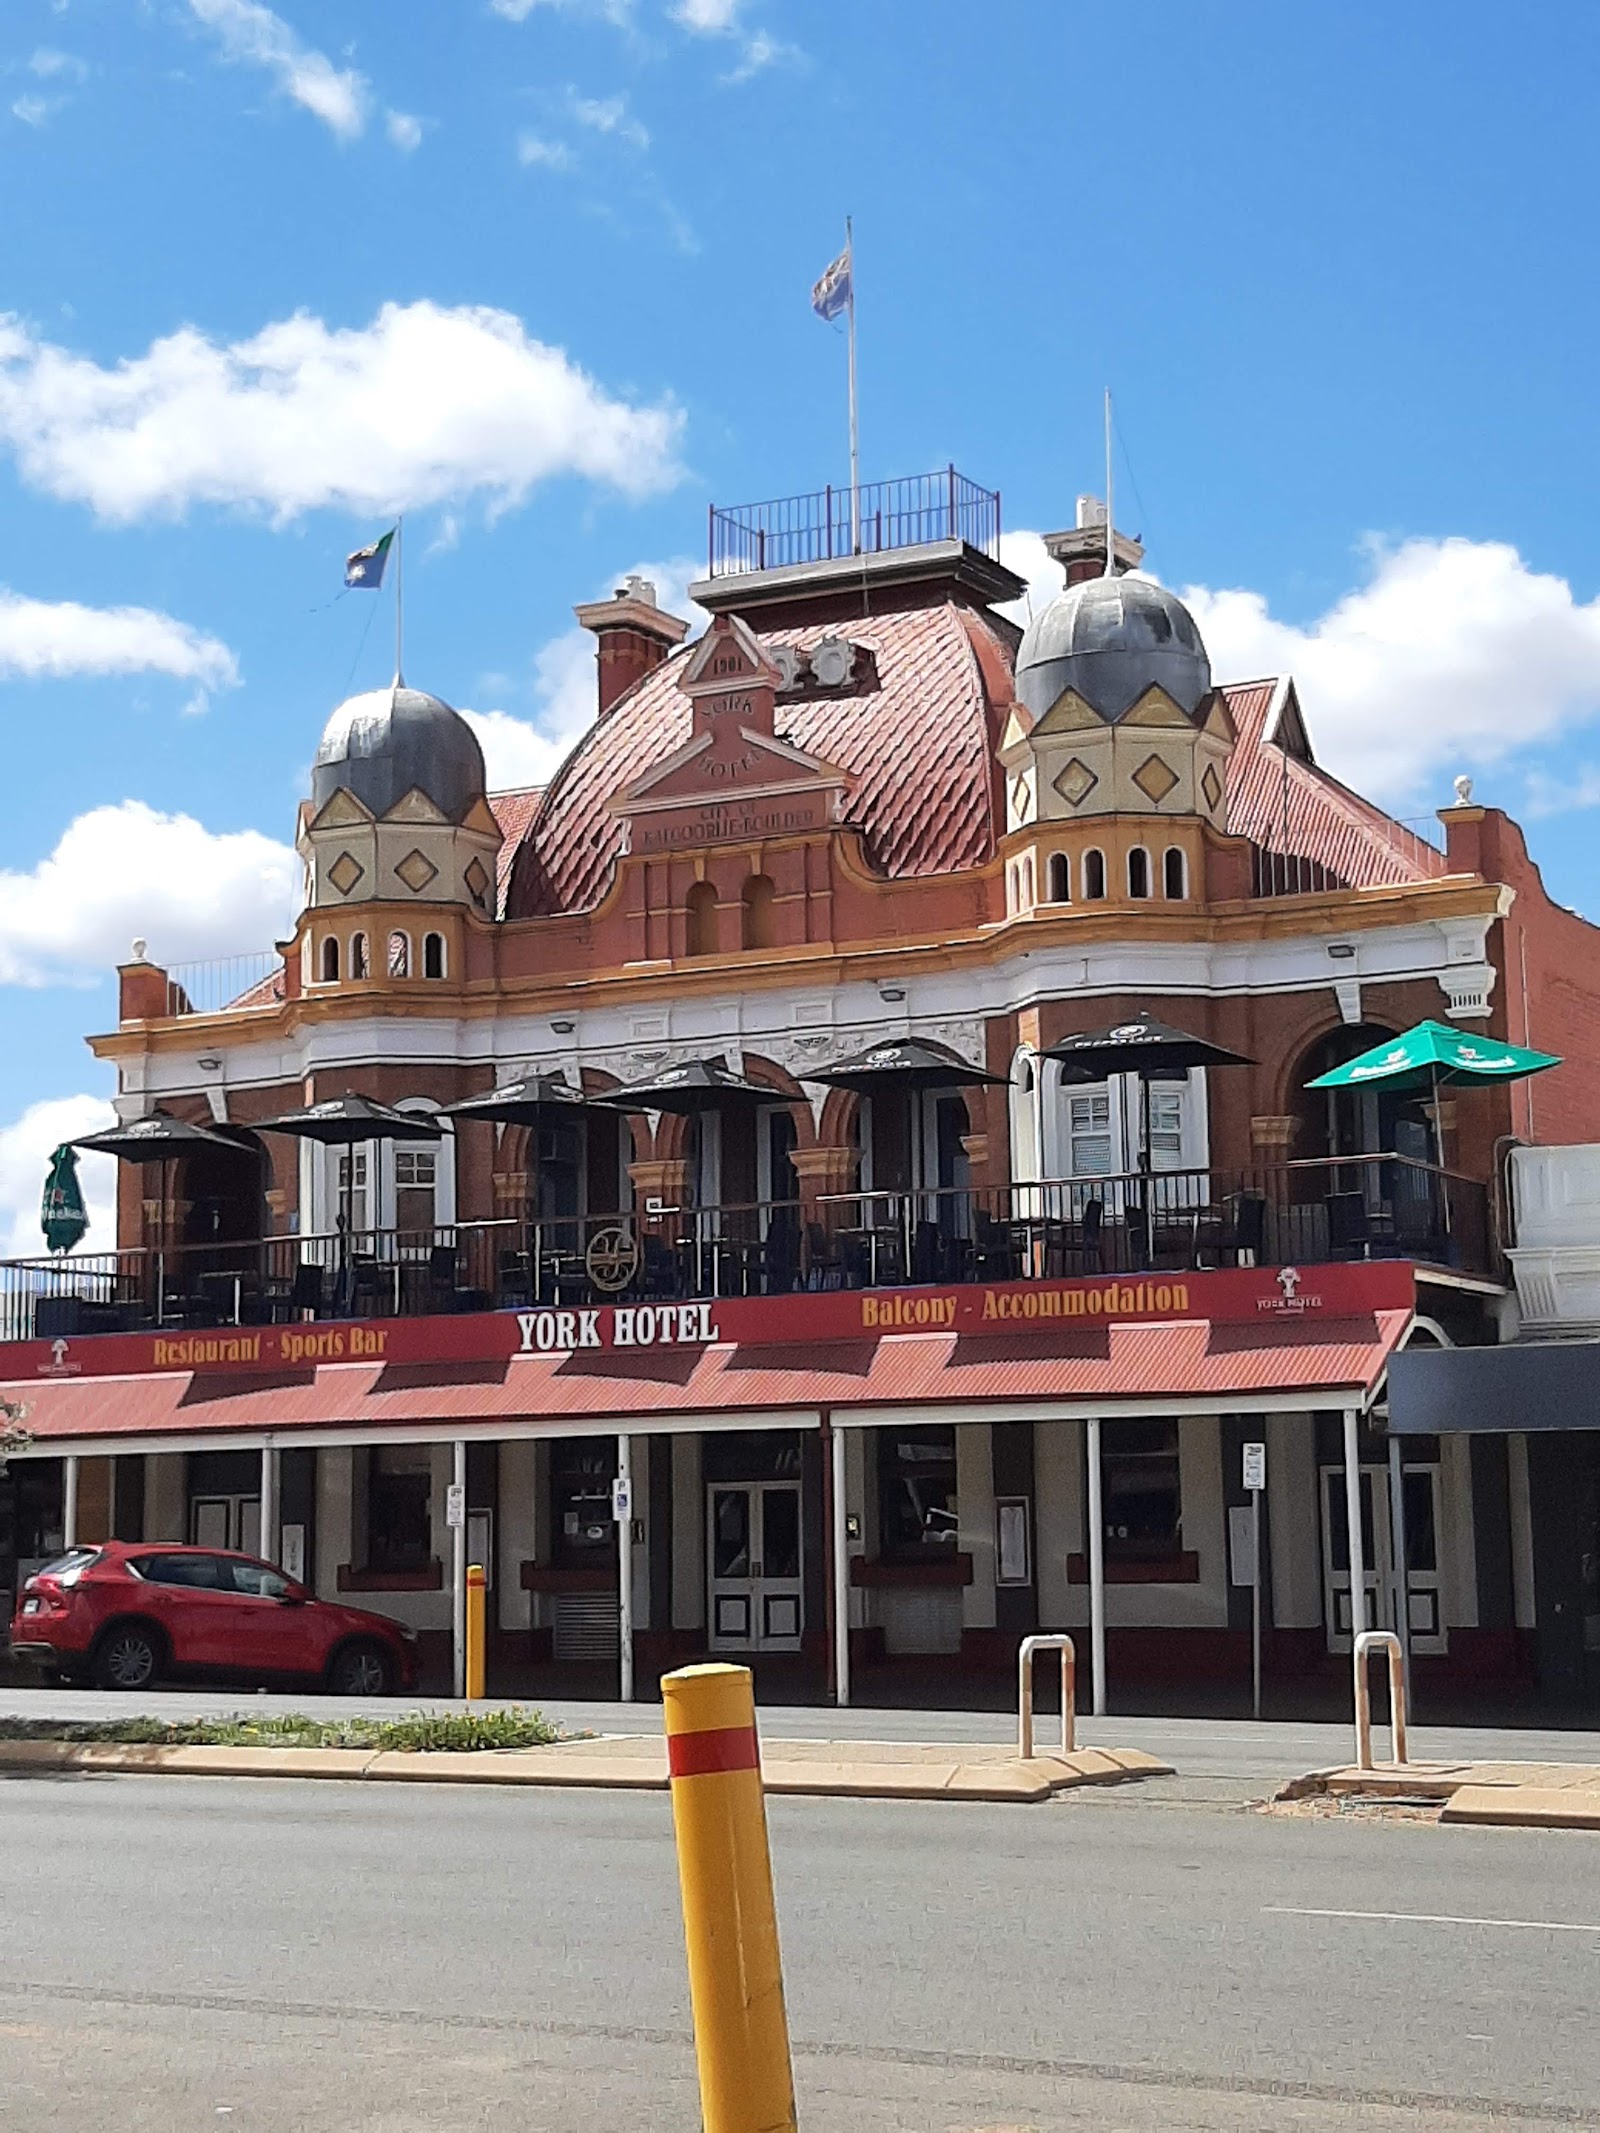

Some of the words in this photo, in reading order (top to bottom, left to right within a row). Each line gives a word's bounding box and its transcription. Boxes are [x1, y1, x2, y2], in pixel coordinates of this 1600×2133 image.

[714, 656, 742, 675] 1901
[701, 693, 753, 718] YORK
[862, 1294, 957, 1328] Balcony
[981, 1283, 1189, 1320] Accommodation
[154, 1333, 261, 1365] Restaurant
[281, 1329, 344, 1362] Sports
[350, 1327, 389, 1355] Bar
[517, 1309, 602, 1351] YORK
[613, 1304, 719, 1346] HOTEL
